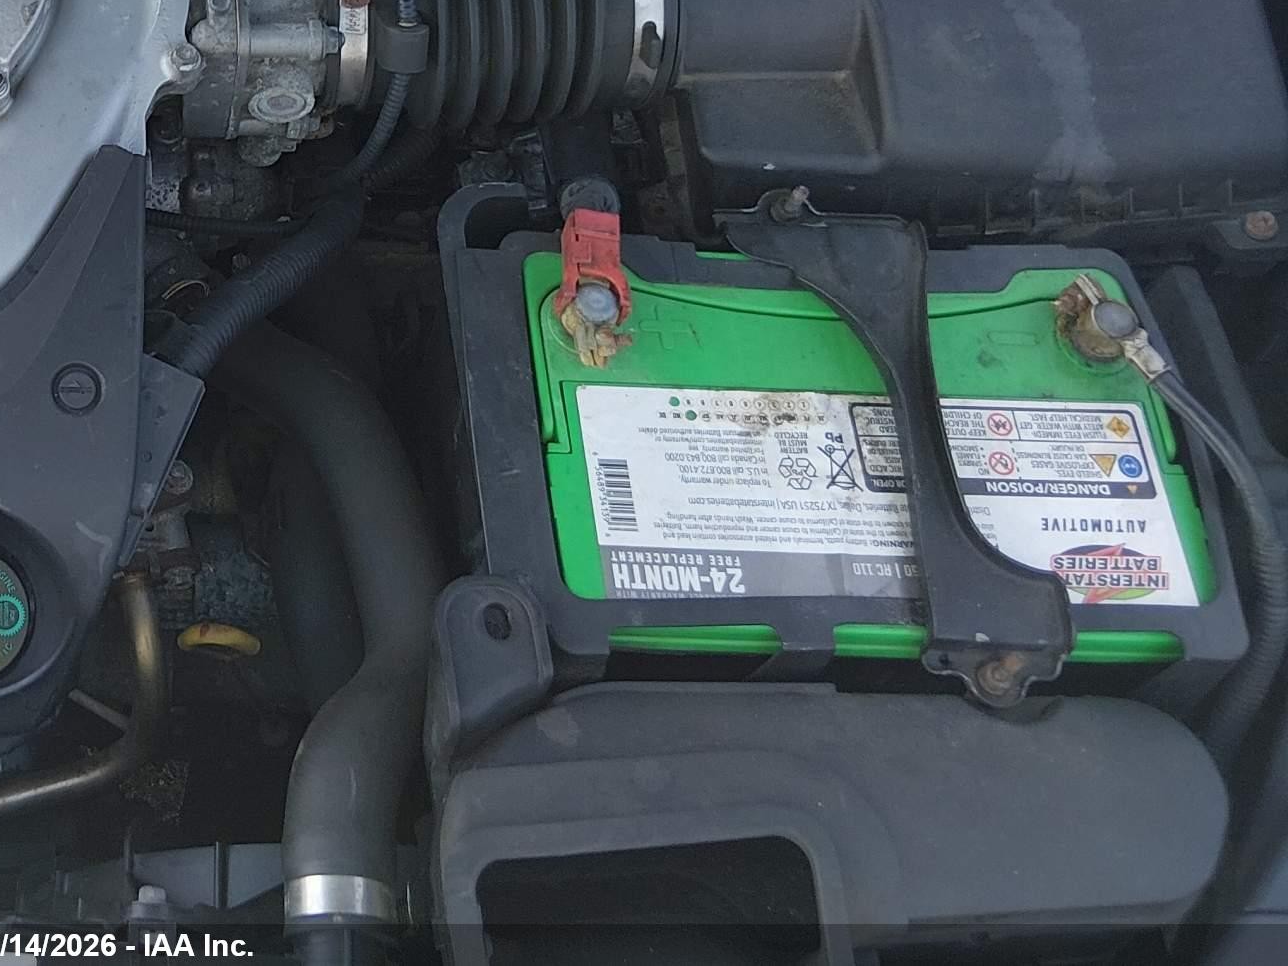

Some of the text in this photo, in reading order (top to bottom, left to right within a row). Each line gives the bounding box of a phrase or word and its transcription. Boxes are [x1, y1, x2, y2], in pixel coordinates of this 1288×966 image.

[825, 432, 843, 443] Pb
[985, 481, 1111, 495] DANGER/POISON
[1040, 517, 1146, 533] AUTOMOTIVE
[610, 550, 740, 566] FREE REPLACEMENT
[1052, 556, 1158, 570] BATTERIES
[852, 562, 874, 574] 110
[876, 564, 890, 574] RC
[611, 563, 746, 594] 24-MONTH
[1061, 573, 1166, 587] INTERSTAT
